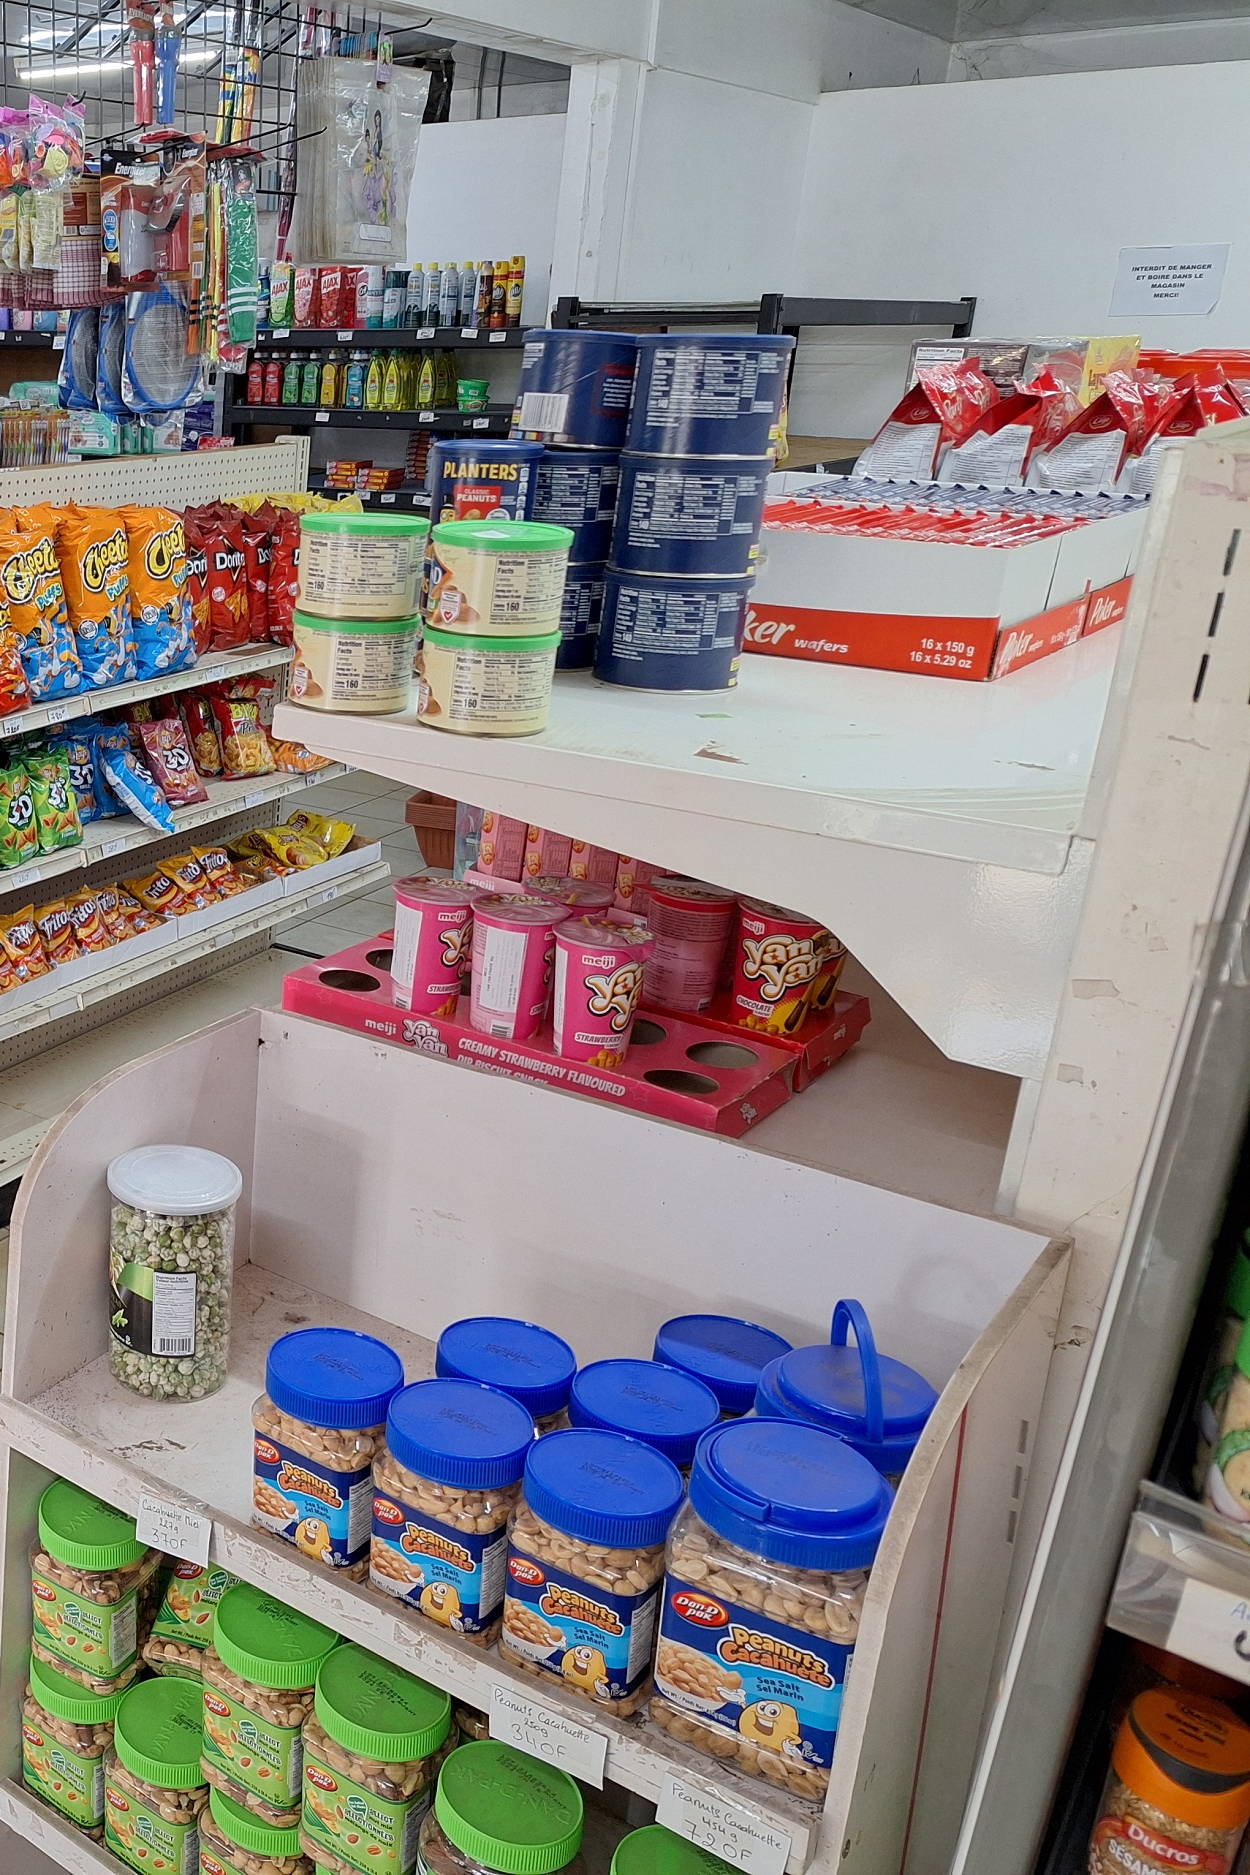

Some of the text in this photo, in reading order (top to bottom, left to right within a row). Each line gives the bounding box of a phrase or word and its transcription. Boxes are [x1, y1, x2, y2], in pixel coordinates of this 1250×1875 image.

[272, 281, 288, 296] AJAX
[296, 278, 311, 291] AJAX
[323, 276, 339, 290] AJAX
[443, 461, 519, 482] PLANTERS
[456, 493, 497, 503] PEANUTS
[497, 567, 514, 575] Facts
[498, 559, 525, 567] Nutrition
[314, 581, 325, 590] 160
[36, 582, 63, 611] Puffs
[506, 602, 520, 612] 160
[1089, 599, 1114, 628] Poker
[338, 640, 362, 648] Nutrition
[794, 637, 849, 655] wafers
[920, 637, 975, 656] 16 x 150 g
[909, 651, 972, 669] 16 x 5.29 oz
[346, 680, 359, 689] 160
[464, 699, 478, 709] 160
[438, 911, 466, 924] meiji
[742, 917, 765, 935] meiji
[582, 955, 615, 969] meiji
[737, 995, 773, 1014] CHOCOLATE
[364, 1017, 398, 1036] meiji
[575, 1033, 622, 1045] STRAWBERRY
[458, 1037, 626, 1098] CREAMY STRAWBERRY FLAVOURED
[254, 1441, 275, 1455] Dan-D
[257, 1450, 272, 1460] pak
[282, 1462, 336, 1498] Peanuts
[304, 1500, 329, 1513] Sea Salt
[373, 1500, 398, 1516] Dan-D
[314, 1509, 332, 1521] Marin
[378, 1510, 395, 1521] pak
[158, 1517, 179, 1535] 227g
[151, 1527, 188, 1550] 370F
[407, 1524, 469, 1561] Peanuts
[431, 1563, 460, 1578] Sea Salt
[509, 1559, 537, 1577] Dan-D
[514, 1571, 535, 1581] pak
[431, 1570, 463, 1586] Sel Marin
[548, 1583, 618, 1626] Peanuts
[676, 1595, 720, 1615] Dan-D
[685, 1607, 715, 1622] pak
[573, 1625, 606, 1642] Sea Salt
[573, 1633, 610, 1650] Sel Marin
[731, 1626, 826, 1675] Peanuts
[756, 1676, 801, 1693] Sea Salt
[756, 1684, 805, 1702] Sel Marin
[204, 1694, 226, 1710] Dan-D
[208, 1703, 224, 1713] pak
[681, 1696, 696, 1708] Poids
[493, 1687, 591, 1745] Peanuts Cacahuette
[523, 1717, 549, 1739] 250g
[510, 1722, 568, 1758] 340F
[306, 1767, 332, 1783] Dan-D
[312, 1777, 330, 1788] pak
[671, 1782, 784, 1851] Peanuts Cacahuette
[702, 1817, 739, 1844] 454 g
[684, 1818, 753, 1862] 720F
[1127, 1823, 1200, 1865] Ducros
